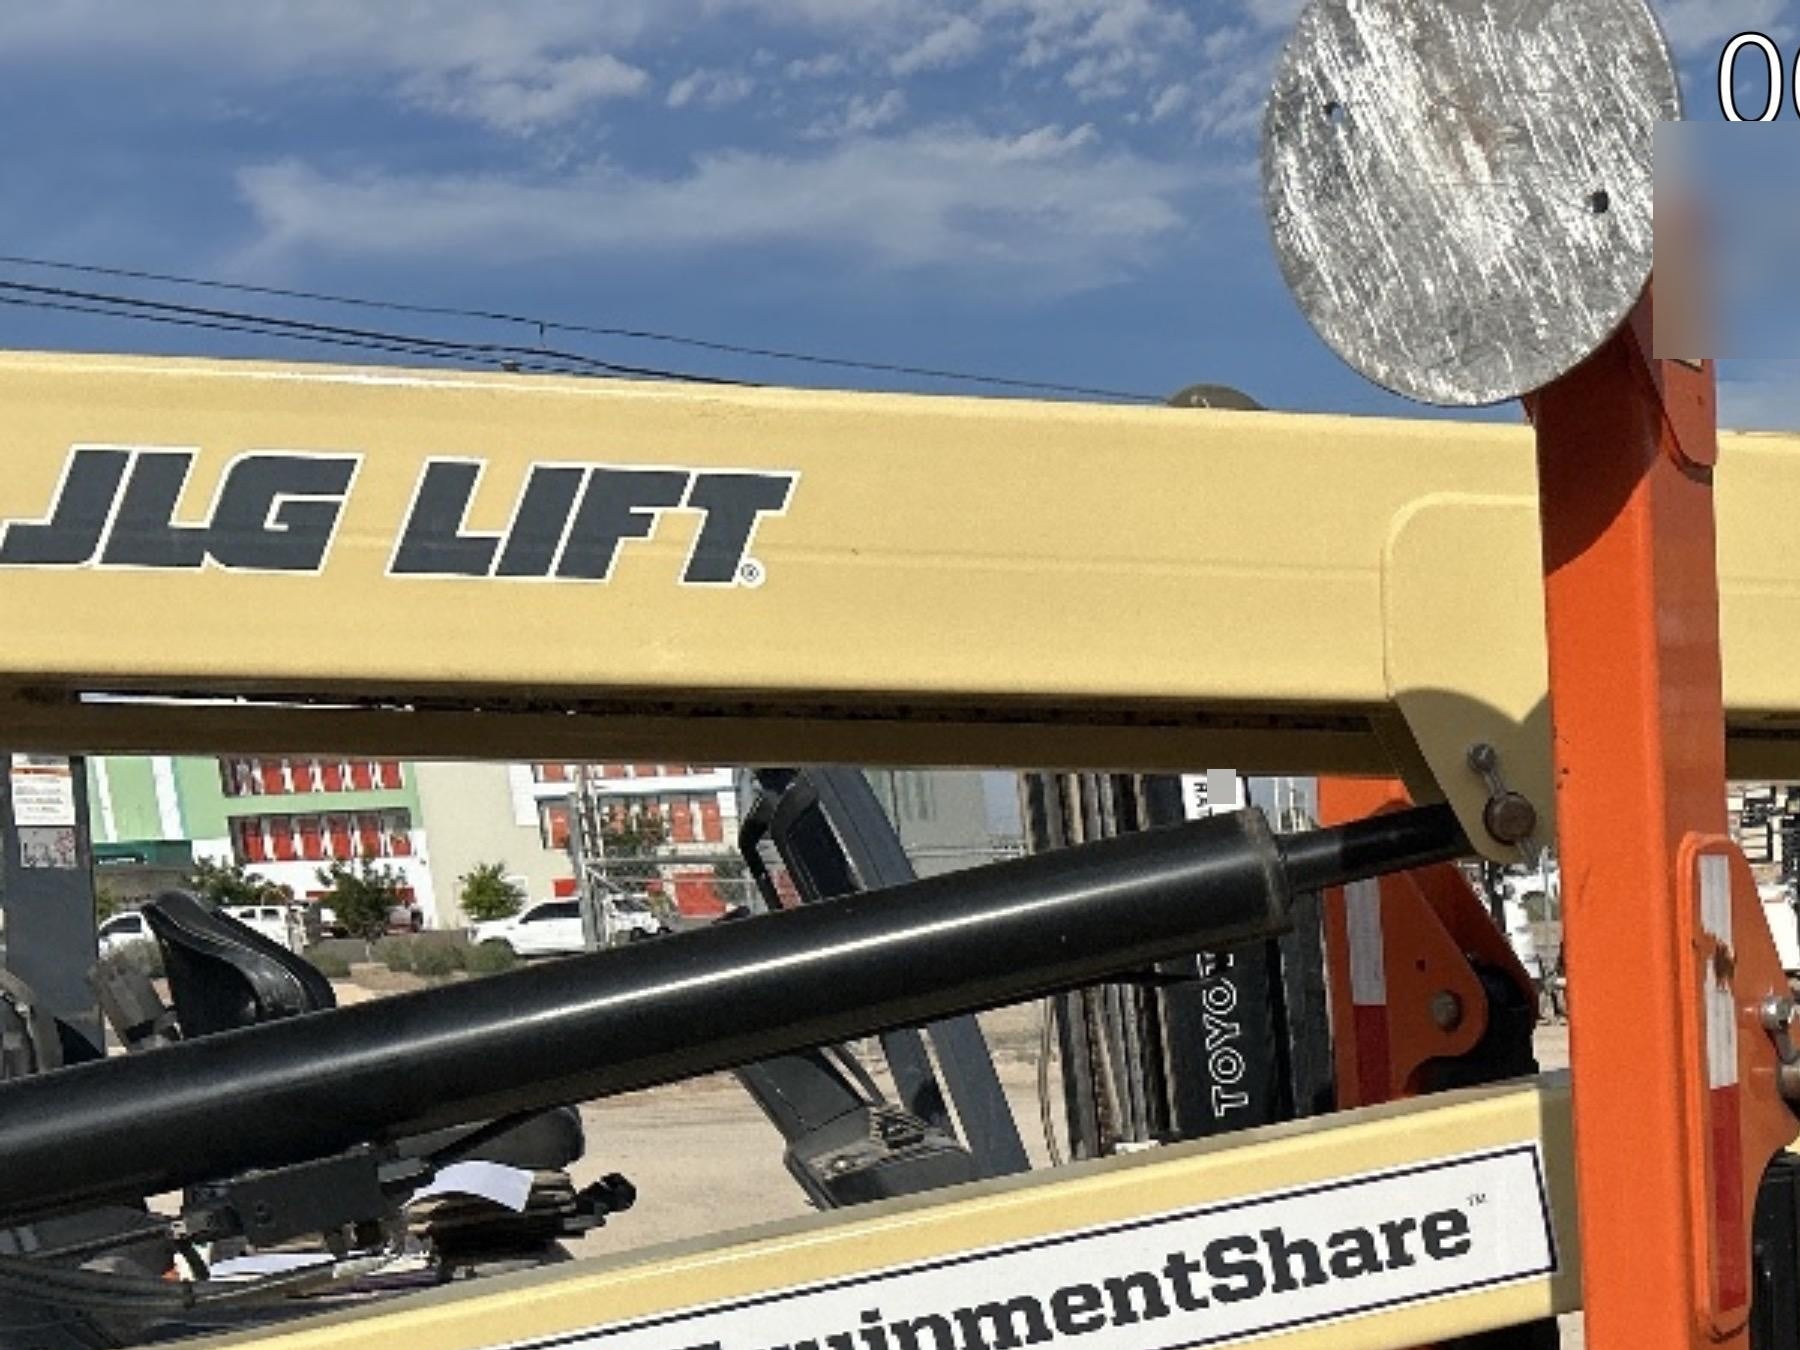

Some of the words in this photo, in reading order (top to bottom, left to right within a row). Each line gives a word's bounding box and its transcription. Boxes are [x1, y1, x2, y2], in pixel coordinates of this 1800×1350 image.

[0, 450, 358, 571] JLG
[390, 462, 793, 583] LIFT
[1195, 952, 1249, 1119] TOYOT
